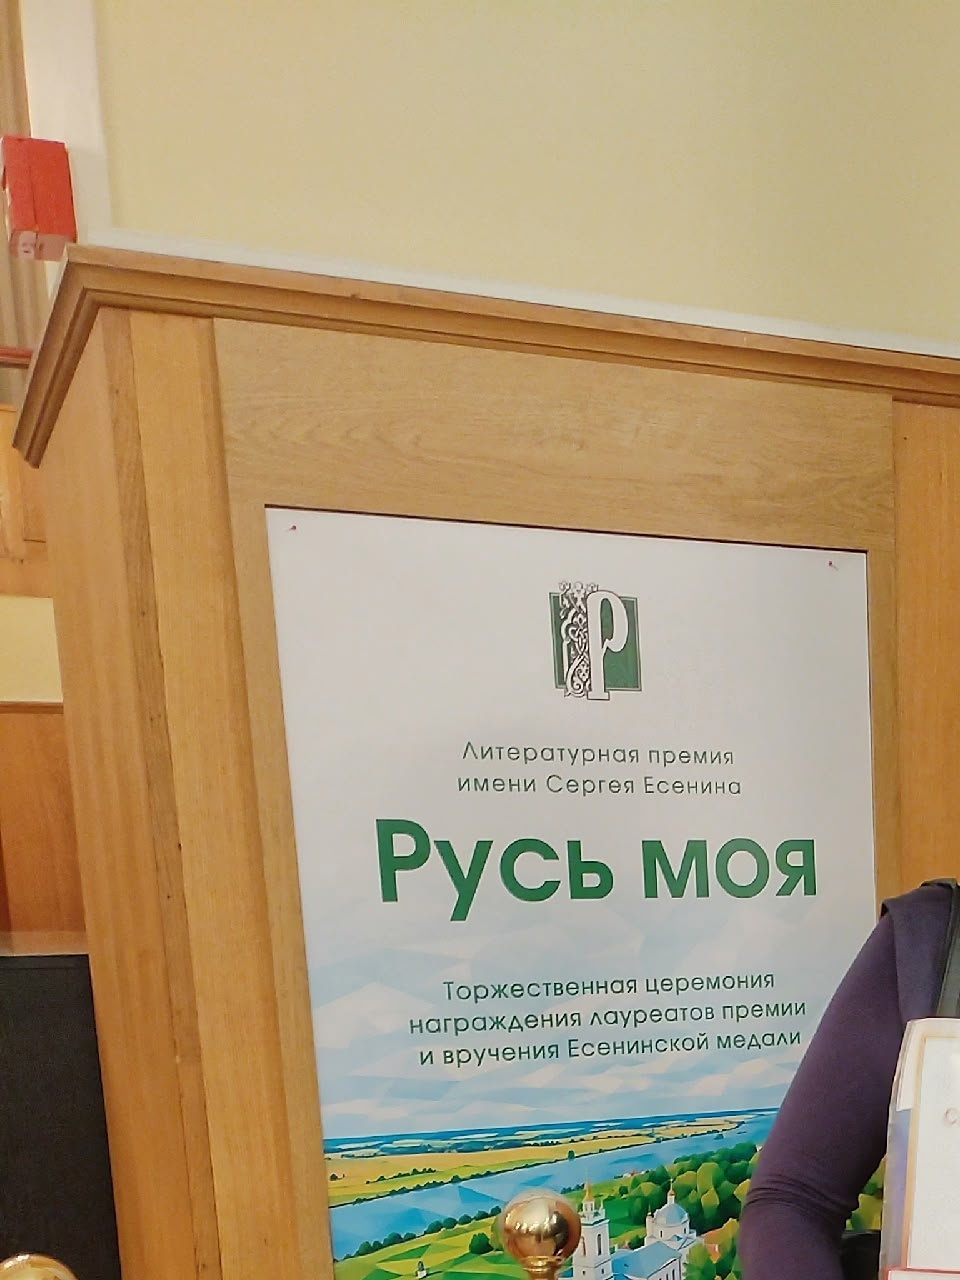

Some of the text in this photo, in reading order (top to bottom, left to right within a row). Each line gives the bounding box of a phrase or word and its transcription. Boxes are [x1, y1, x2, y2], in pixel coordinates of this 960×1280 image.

[462, 741, 734, 768] Литературная премия
[457, 774, 741, 797] имени Сергея Есенина
[375, 818, 817, 922] Русь моя
[443, 973, 774, 1004] Торжественная церемония
[409, 1002, 806, 1037] награждения лауреатов премии
[419, 1031, 801, 1069] и вручения Есенинской медали
